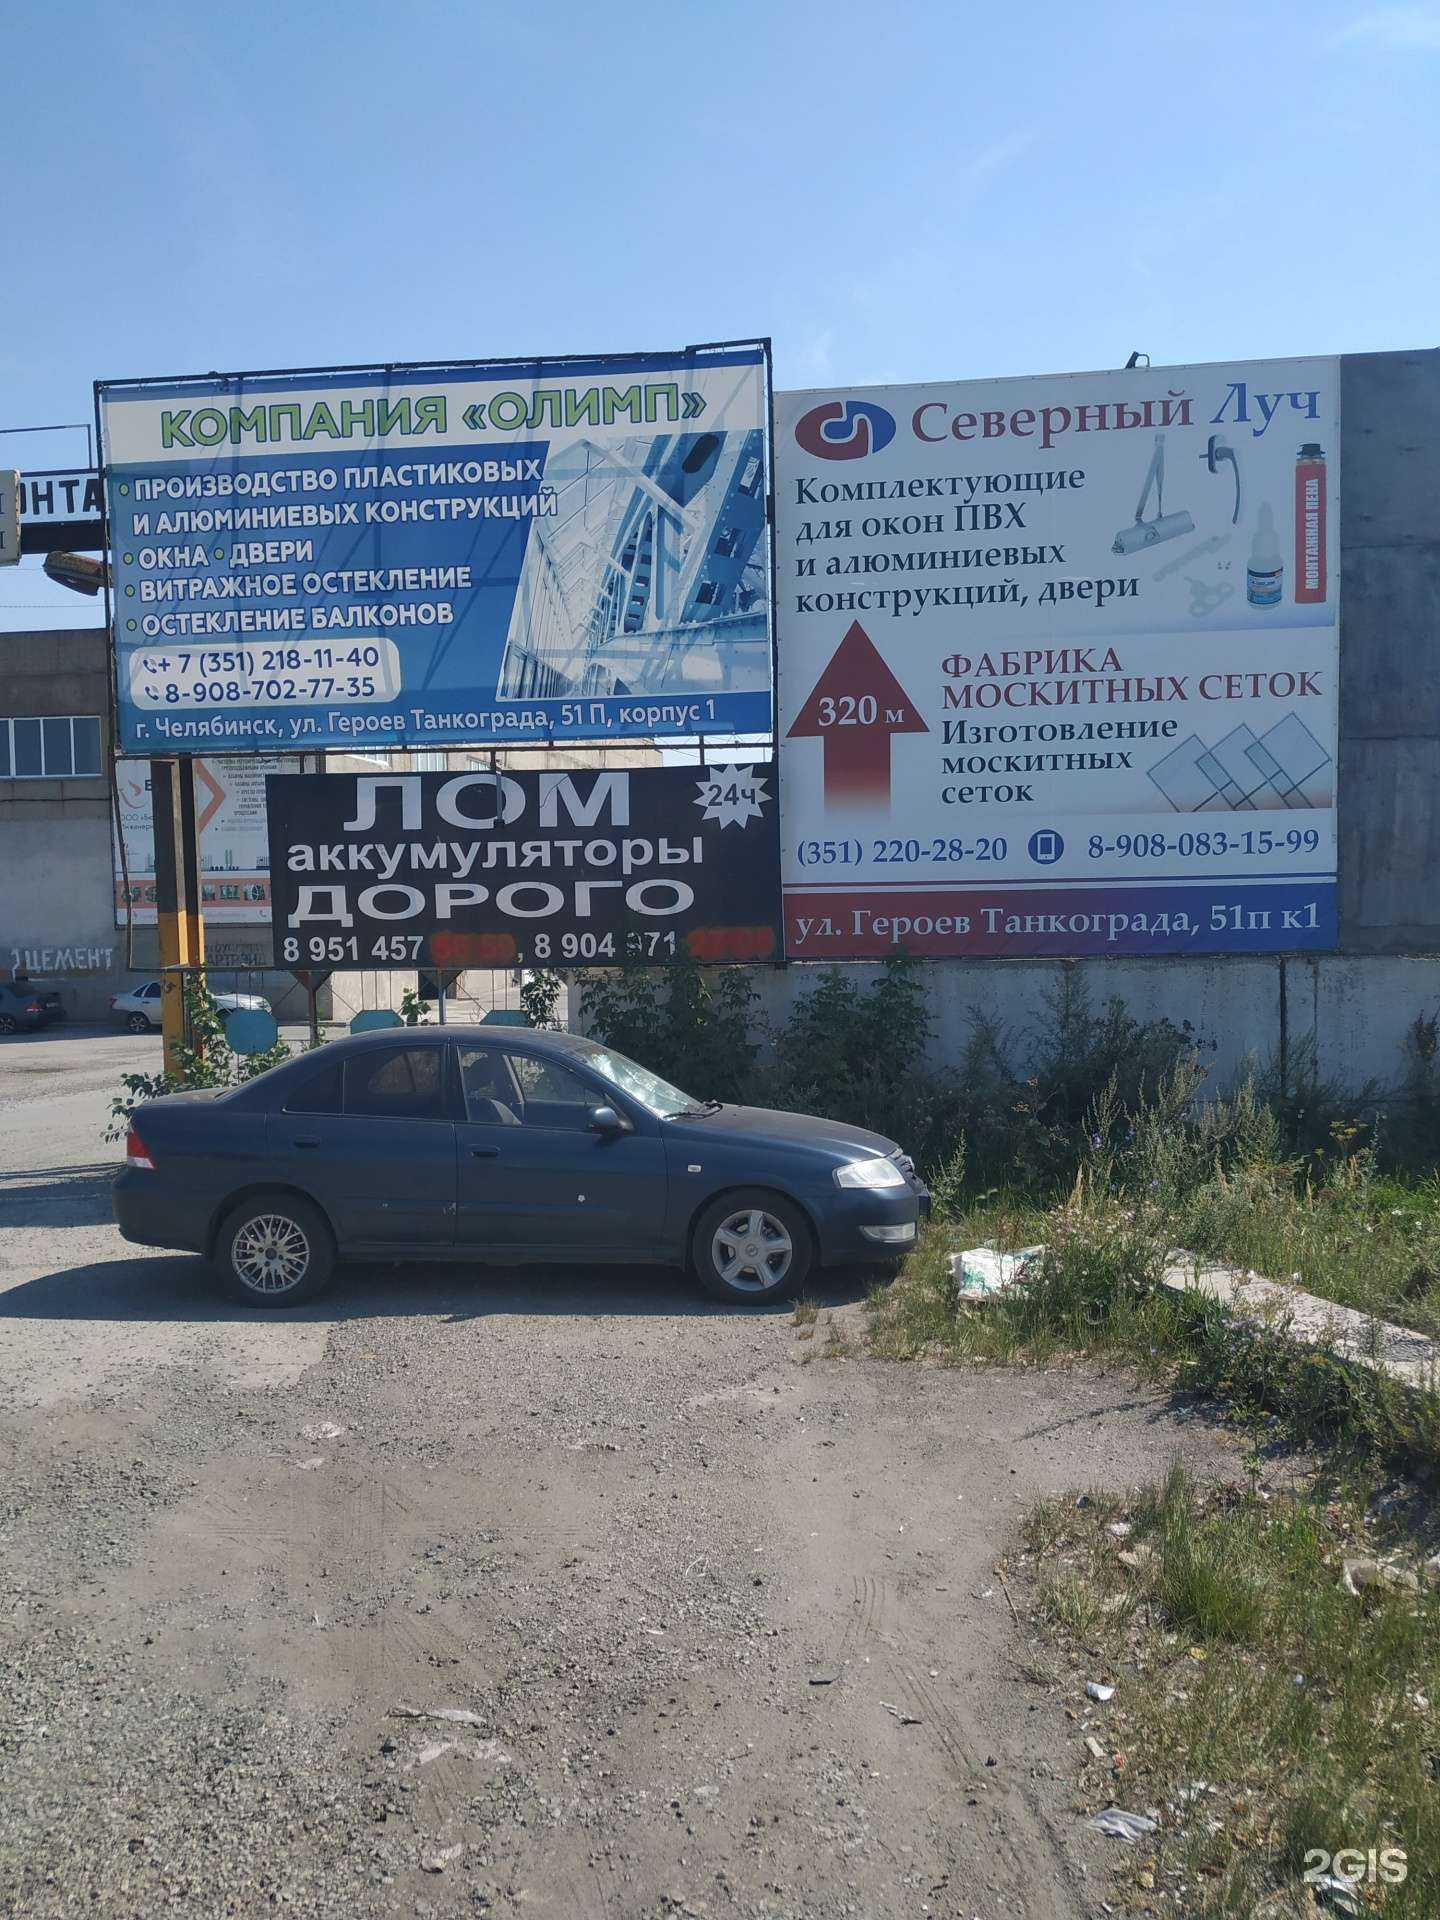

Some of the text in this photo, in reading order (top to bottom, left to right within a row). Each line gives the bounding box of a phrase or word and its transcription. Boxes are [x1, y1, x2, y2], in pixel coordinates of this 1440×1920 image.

[161, 383, 707, 448] КОМПАНИЯ «ОЛИМП»
[912, 383, 1321, 449] Северный Луч
[135, 458, 543, 500] ПРОИЗВОДСТВО ПЛАСТИКОВЫХ
[795, 469, 1085, 504] Комплектующие
[133, 487, 558, 536] И АЛЮМИНИЕВЫХ КОНСТРУКЦИЙ
[796, 502, 1027, 546] для окон ПВХ
[1305, 479, 1319, 590] МОНТАЖНАЯ ПЕНА
[138, 540, 313, 570] ОКНА ДВЕРИ
[796, 544, 1066, 577] и алюминиевых
[140, 566, 472, 602] ВИТРАЖНОЕ ОСТЕКЛЕНИЕ
[796, 577, 1140, 617] конструкций, двери
[141, 602, 454, 636] ОСТЕКЛЕНИЕ БАЛКОНОВ
[179, 653, 191, 674] 7
[200, 651, 254, 677] (351)
[262, 646, 379, 671] 218-11-40
[942, 647, 1124, 678] ФАБРИКА
[165, 677, 376, 703] 8-908-702-77-35
[941, 671, 1323, 709] МОСКИТНЫХ СЕТОК
[136, 698, 715, 740] г. Челябинск, ул. Героев Танкограда, 51 П, корпус 1
[818, 695, 905, 726] 320 м
[942, 718, 1178, 745] Изготовление
[942, 751, 1133, 774] москитных
[343, 772, 630, 831] ЛОМ
[708, 783, 756, 806] 24ч
[941, 784, 1034, 804] сеток
[287, 836, 703, 880] аккумуляторы
[797, 837, 1007, 868] (351) 220-28-20
[1088, 829, 1320, 859] 8-908-083-15-99
[287, 879, 695, 928] ДОРОГО
[796, 917, 842, 945] ул.
[852, 910, 971, 944] Героев
[980, 908, 1200, 941] Танкограда,
[1210, 904, 1271, 932] 51п
[1281, 902, 1320, 929] к1
[283, 936, 299, 962] 8
[308, 936, 359, 962] 951
[371, 935, 424, 961] 457
[534, 933, 551, 959] 8
[561, 932, 616, 959] 904
